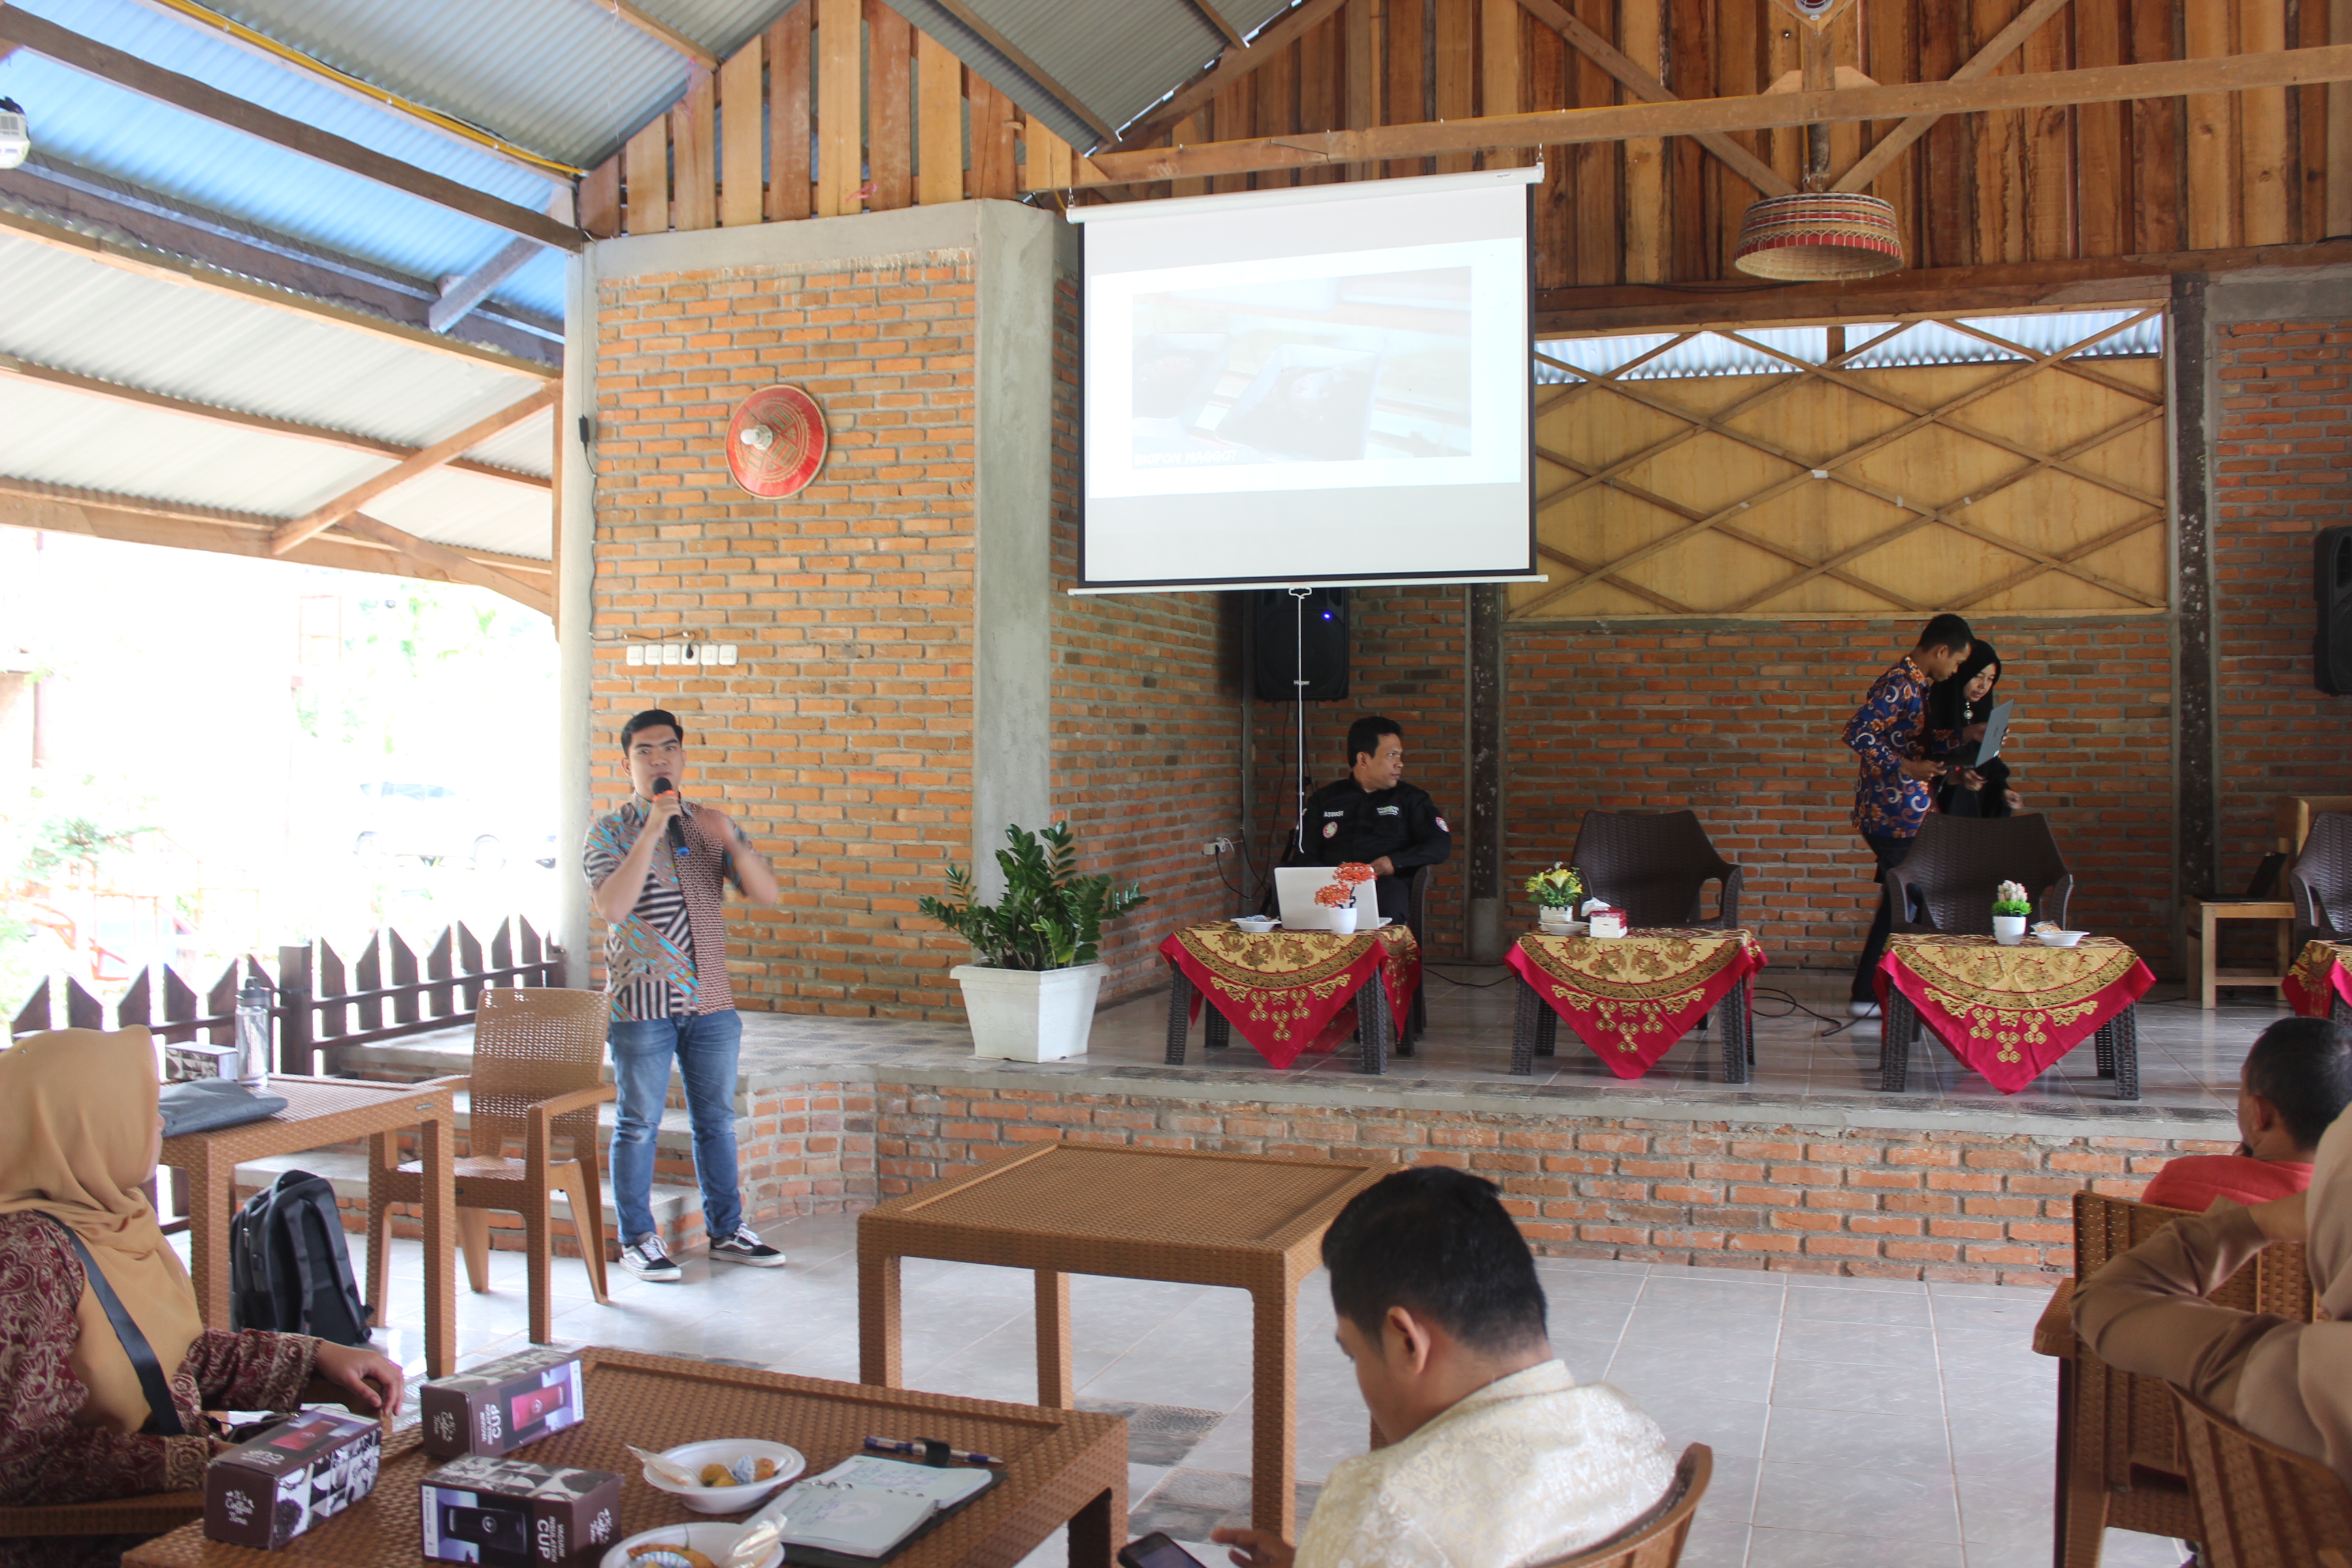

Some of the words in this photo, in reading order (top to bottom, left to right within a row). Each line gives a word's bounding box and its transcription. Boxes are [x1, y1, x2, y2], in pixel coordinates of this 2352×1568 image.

[1185, 449, 1238, 464] MAGGOT
[490, 1403, 502, 1439] CUP
[536, 1518, 551, 1559] CUP
[549, 1515, 558, 1563] INSULATION
[557, 1523, 566, 1558] VACUUM
